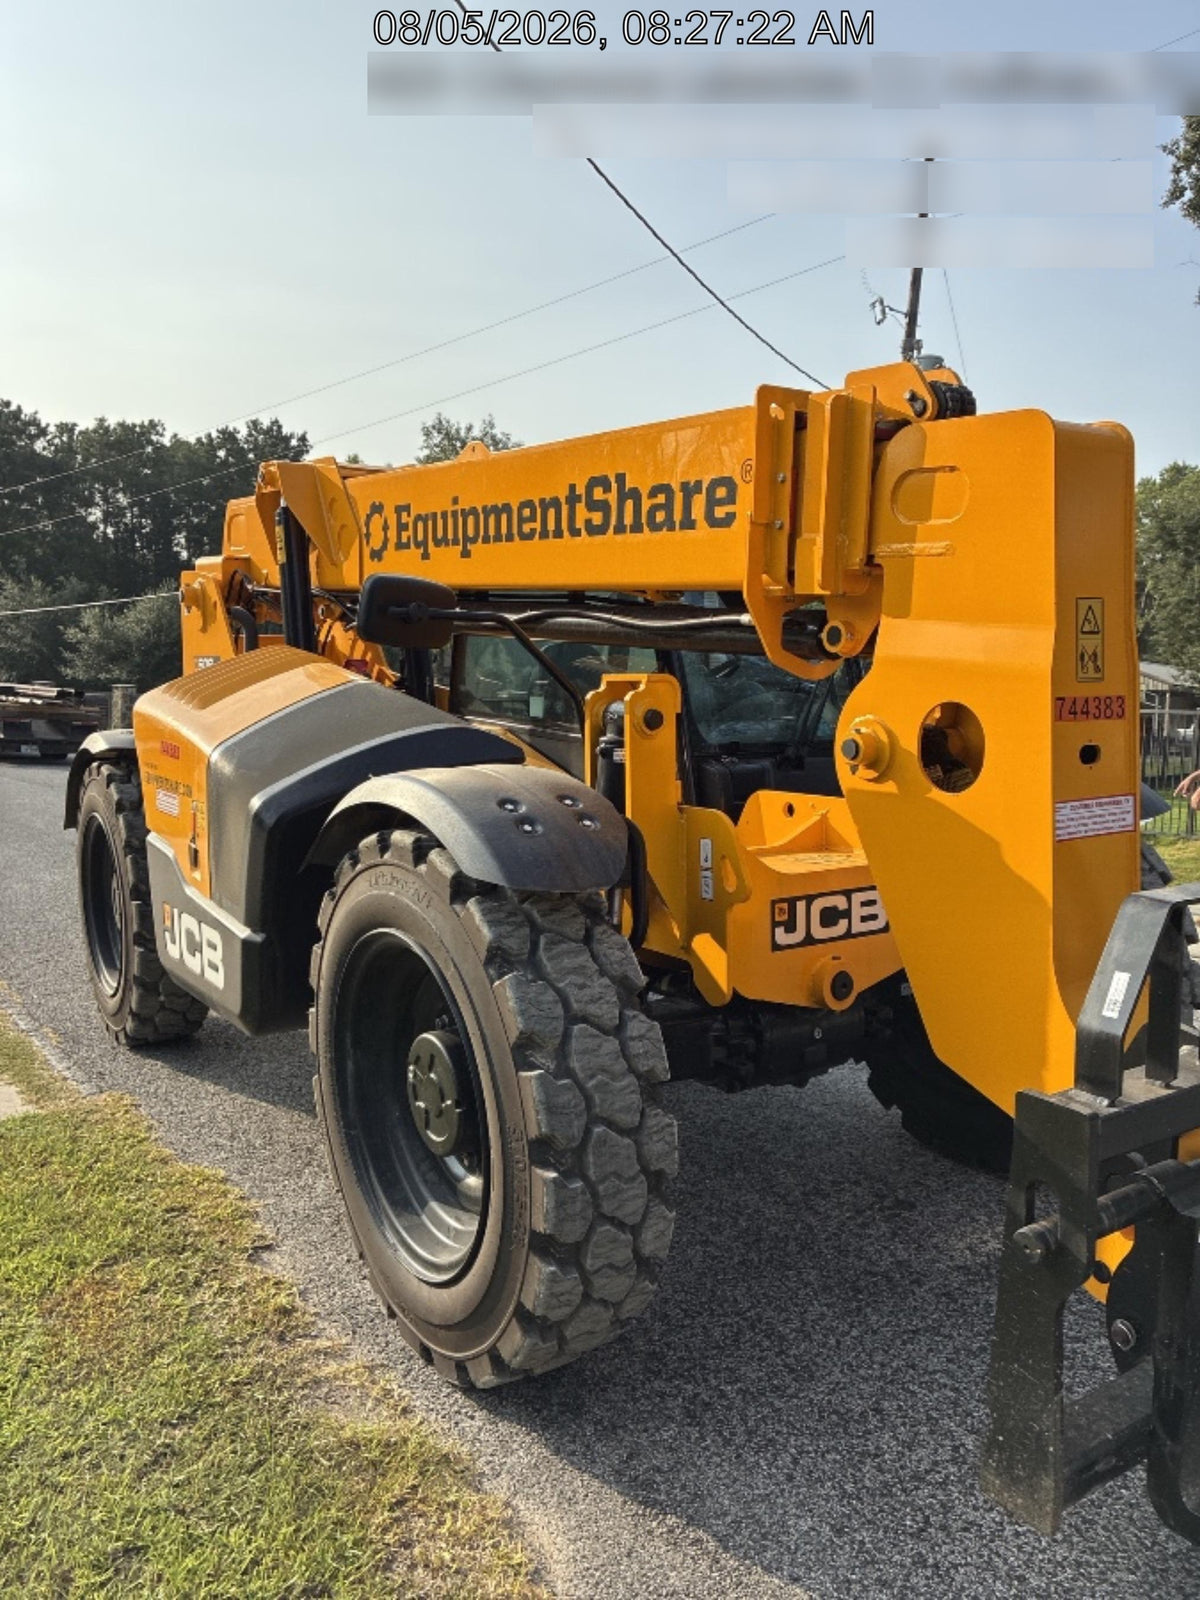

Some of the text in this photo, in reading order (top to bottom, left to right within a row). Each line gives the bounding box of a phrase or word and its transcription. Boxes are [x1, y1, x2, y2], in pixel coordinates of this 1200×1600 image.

[394, 472, 738, 560] EquipmentShare
[1055, 695, 1126, 721] 744383
[164, 908, 225, 990] JCB
[774, 890, 888, 946] JCB
